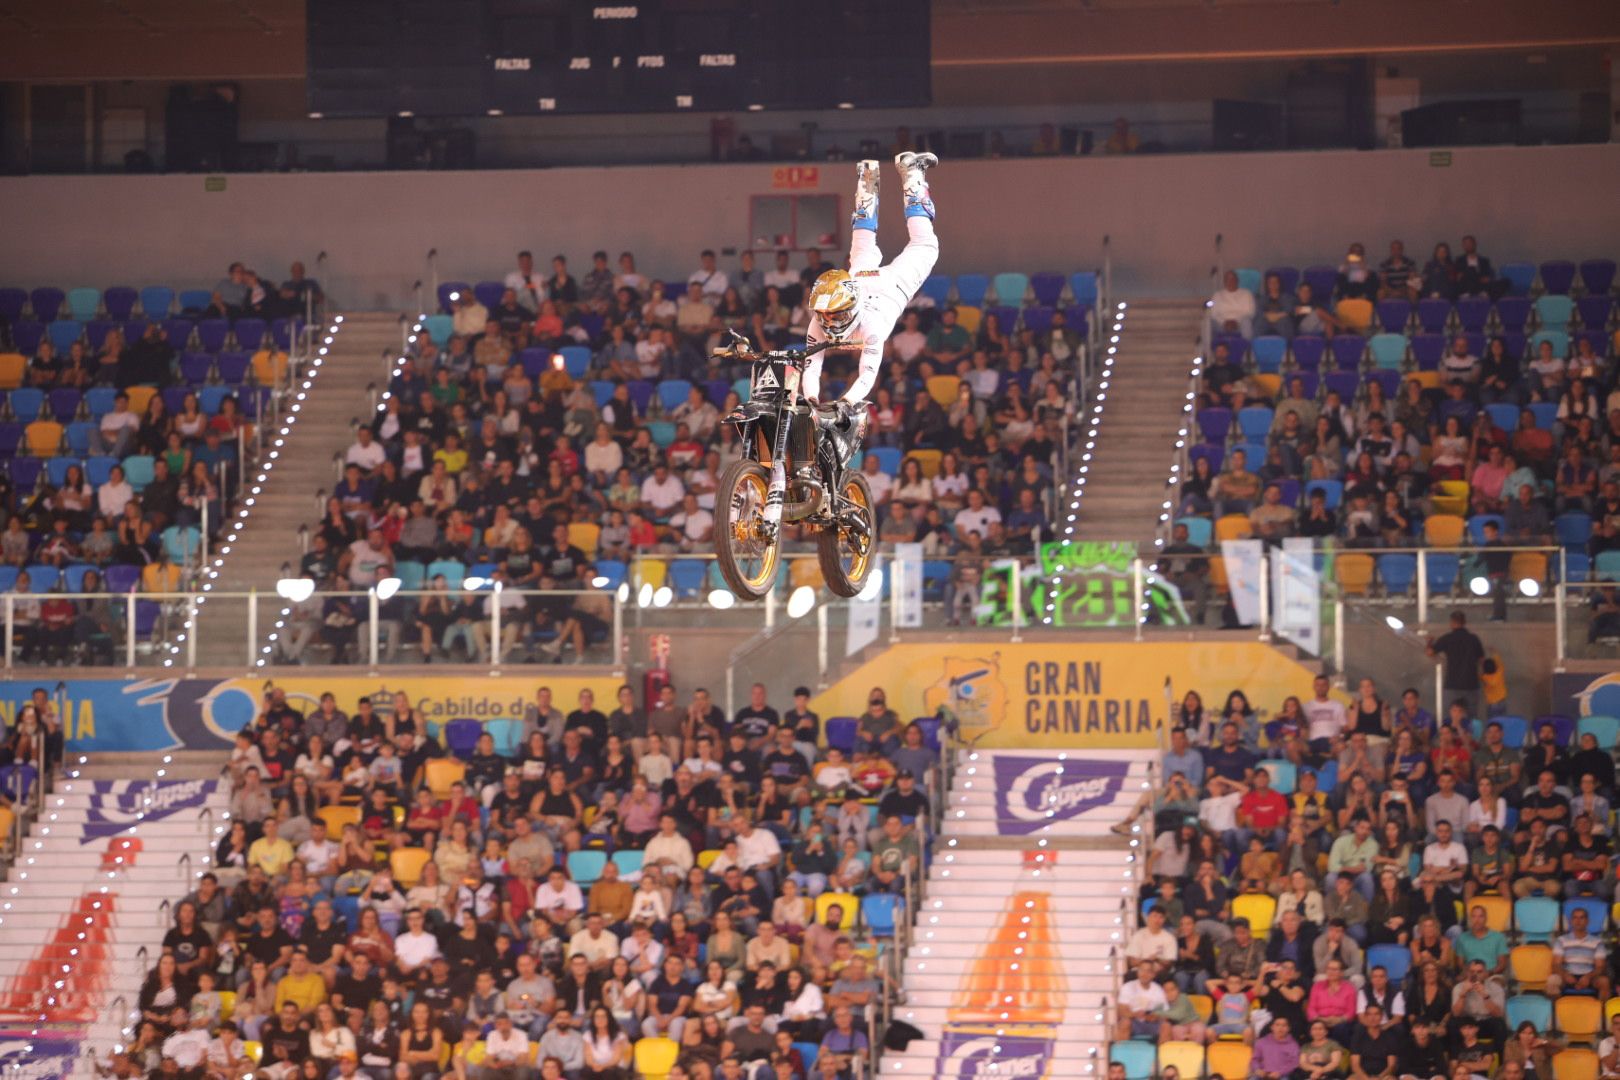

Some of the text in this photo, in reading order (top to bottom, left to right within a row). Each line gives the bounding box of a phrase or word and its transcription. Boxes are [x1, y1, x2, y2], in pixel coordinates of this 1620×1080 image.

[593, 7, 638, 19] PERIODO
[494, 58, 531, 70] FALTAS
[569, 57, 591, 69] JUG
[637, 55, 665, 68] PTOS
[699, 54, 736, 66] FALTAS
[1025, 661, 1102, 695] GRAN
[417, 696, 503, 716] Cabildo
[1025, 699, 1152, 734] CANARIA
